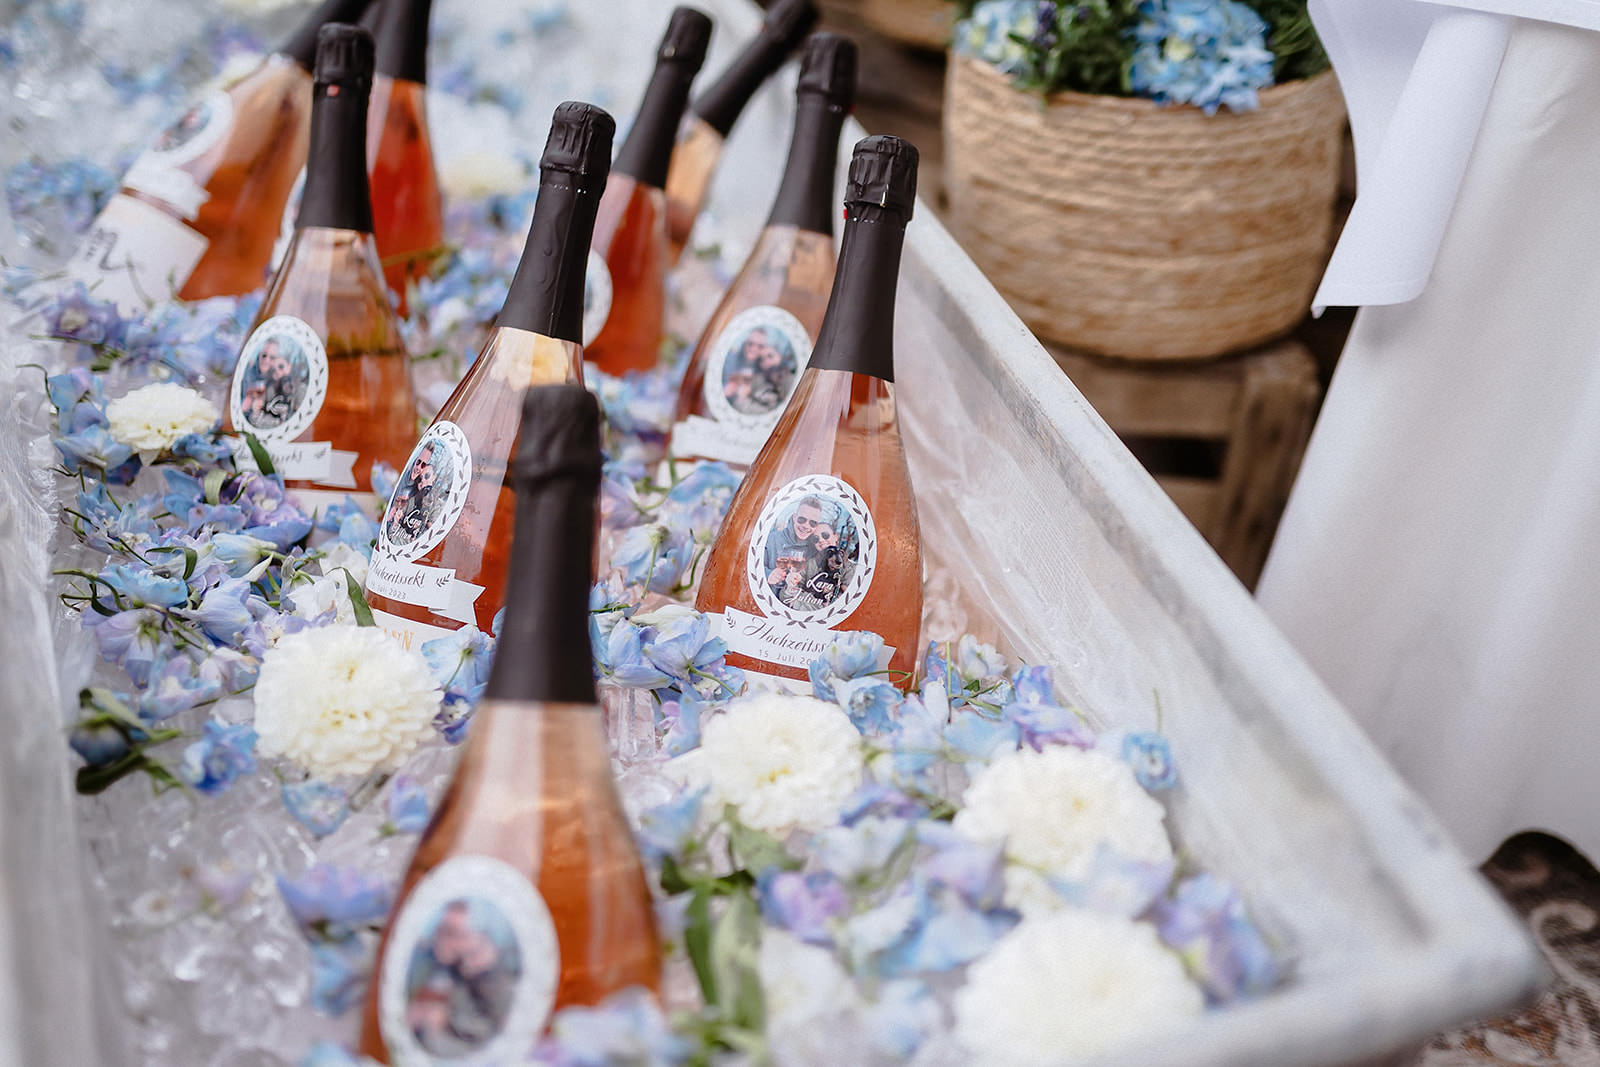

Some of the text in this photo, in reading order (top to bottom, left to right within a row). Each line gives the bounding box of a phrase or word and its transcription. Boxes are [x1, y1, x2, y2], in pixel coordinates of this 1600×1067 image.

[806, 572, 833, 593] Lara
[388, 587, 407, 600] 2023
[783, 588, 824, 606] Julian
[743, 616, 827, 653] Hochzeitss
[776, 654, 796, 664] Juli
[799, 657, 812, 666] 20
